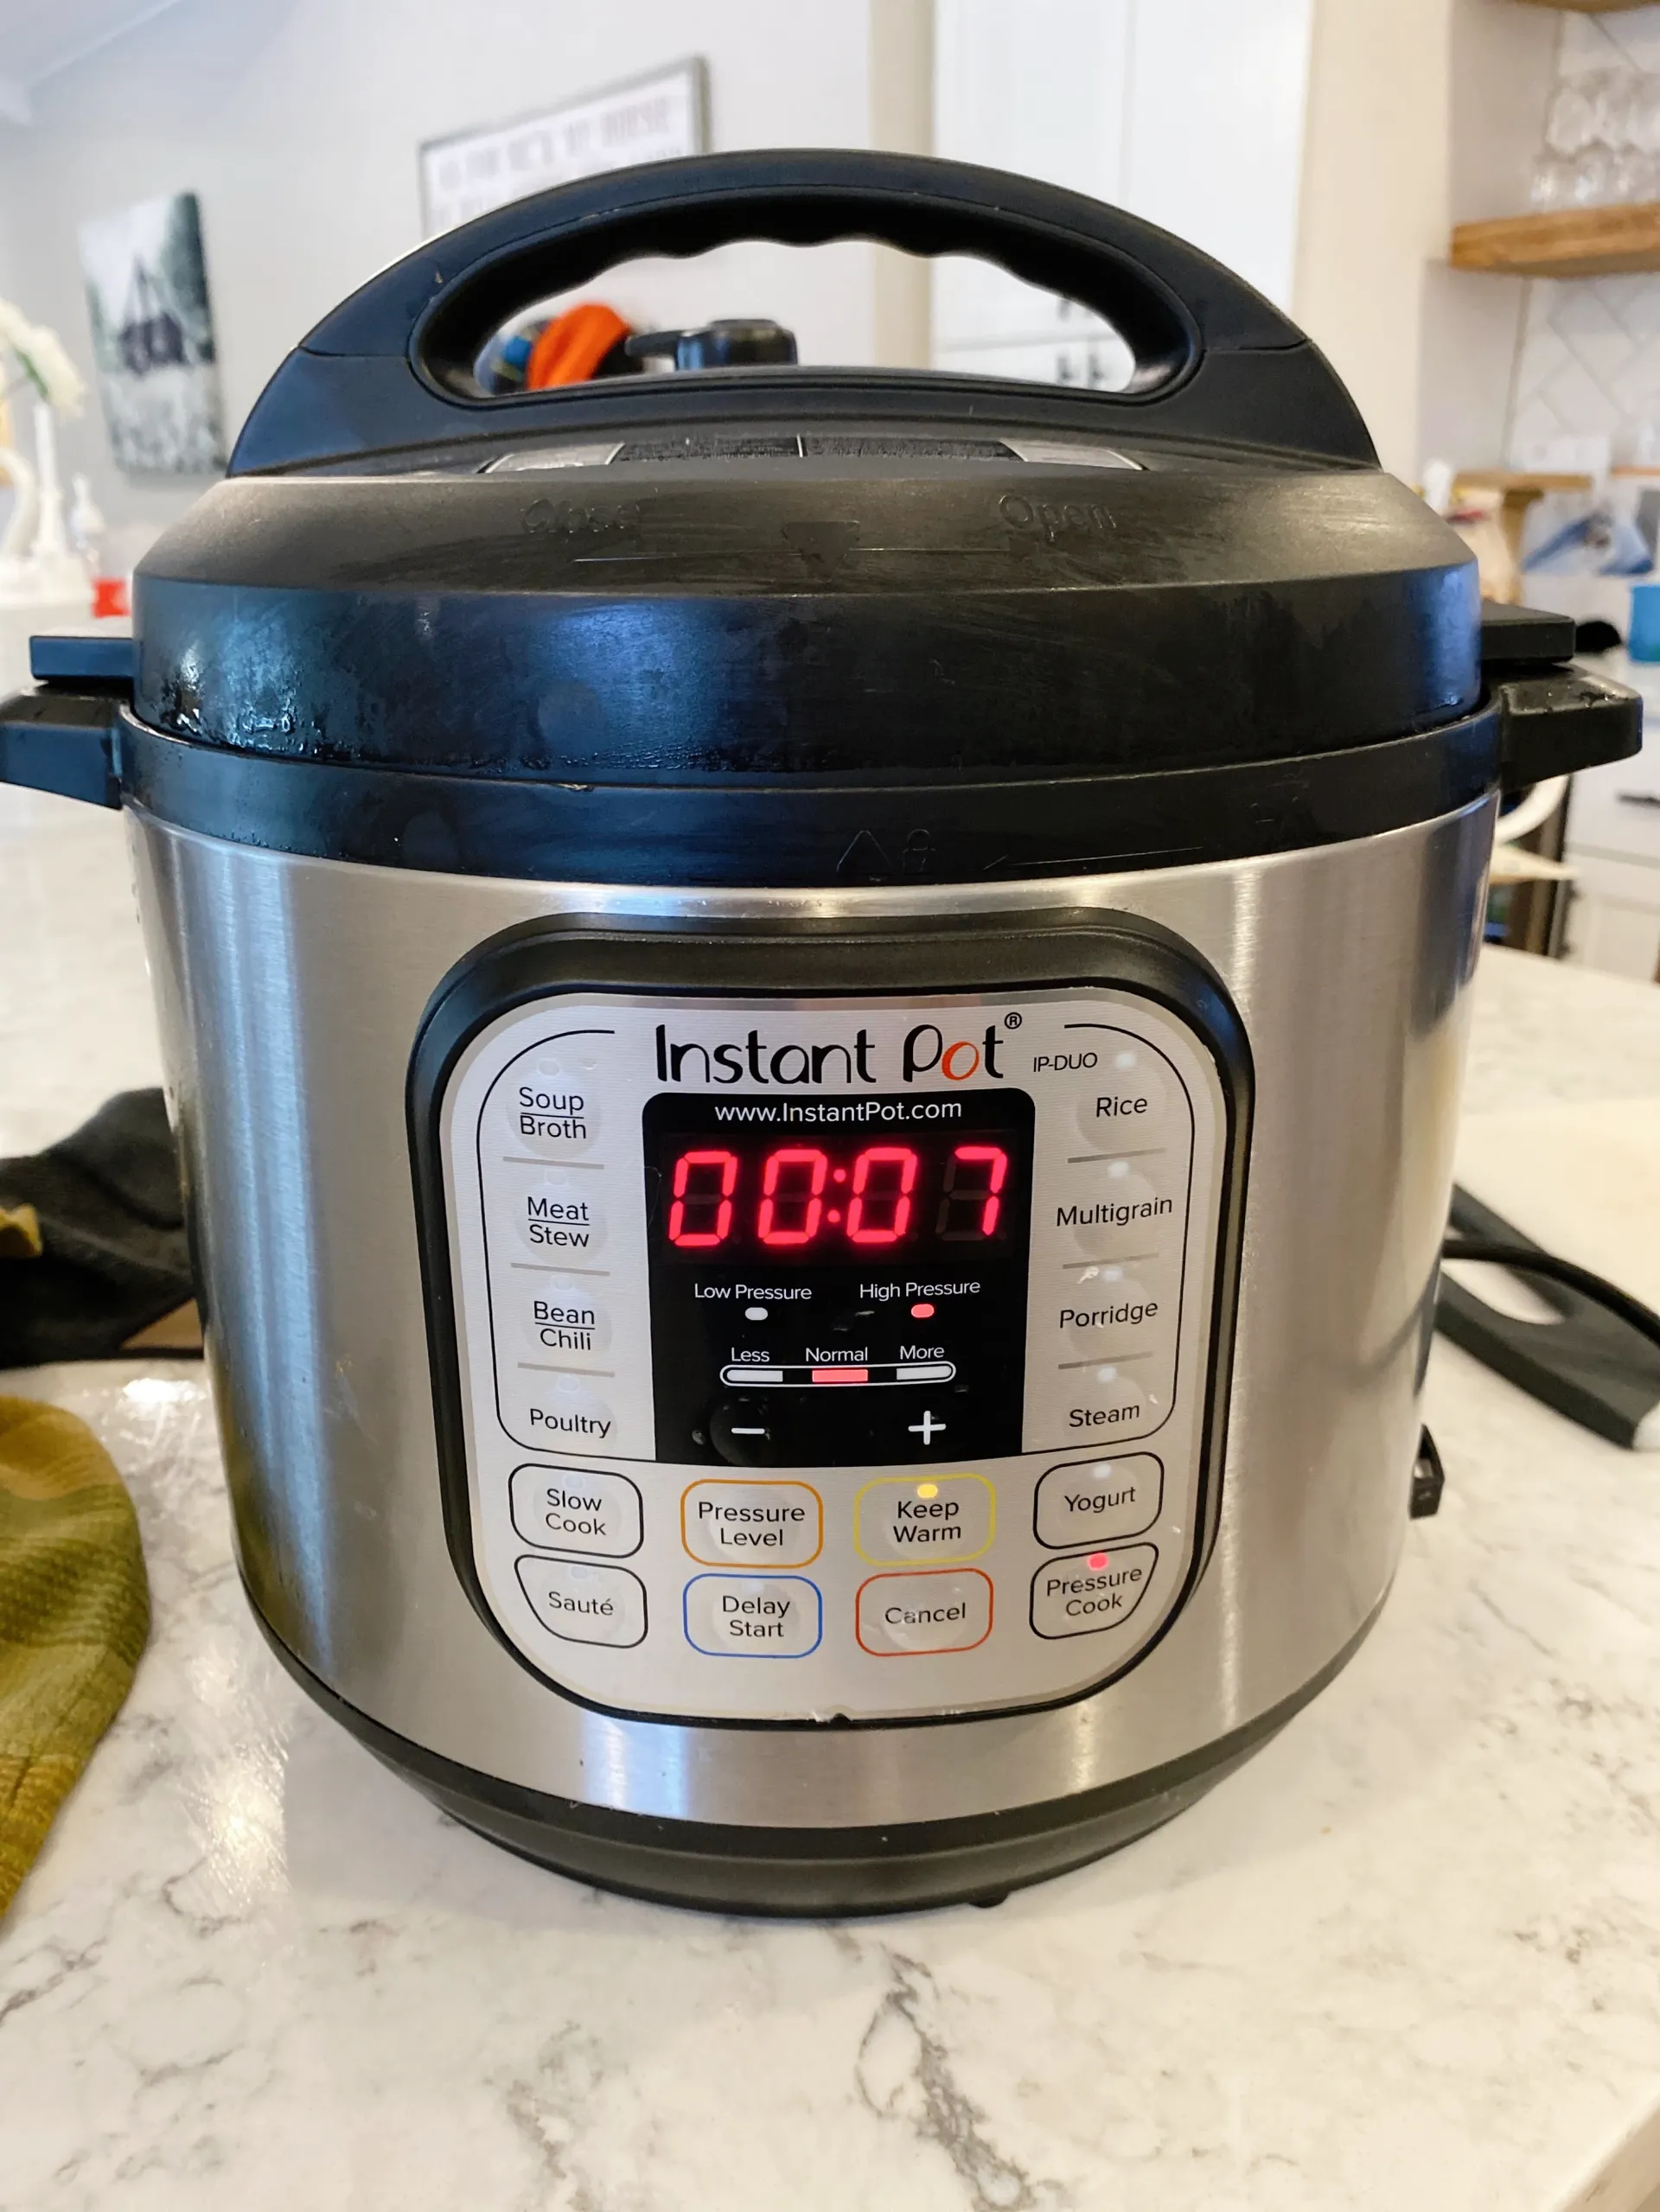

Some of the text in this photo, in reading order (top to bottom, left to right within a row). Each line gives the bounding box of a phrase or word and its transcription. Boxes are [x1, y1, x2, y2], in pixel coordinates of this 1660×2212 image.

[997, 494, 1117, 543] Open
[655, 1023, 876, 1085] Instant
[1032, 1051, 1099, 1074] IP-DUO
[519, 1087, 584, 1115] Soup
[714, 1100, 962, 1123] www.InstantPot.com
[1095, 1094, 1149, 1119] Rice
[520, 1116, 588, 1140] Broth
[527, 1196, 590, 1221] Meat
[1056, 1196, 1174, 1227] Multigrain
[528, 1224, 591, 1248] Stew
[694, 1283, 813, 1301] Low Pressure
[859, 1279, 981, 1302] High Pressure
[533, 1300, 596, 1325] Bean
[1059, 1300, 1159, 1329] Porridge
[540, 1329, 592, 1351] Chili
[731, 1348, 770, 1363] Less
[806, 1346, 869, 1363] Normal
[899, 1344, 945, 1361] More
[529, 1408, 612, 1438] Poultry
[1069, 1404, 1140, 1429] Steam
[546, 1488, 603, 1512] Slow
[698, 1501, 806, 1522] Pressure
[897, 1498, 960, 1521] Keep
[1063, 1485, 1137, 1514] Yogurt
[545, 1512, 607, 1536] Cook
[892, 1524, 962, 1544] Warm
[719, 1527, 784, 1546] Level
[1045, 1566, 1143, 1597] Pressure
[547, 1591, 615, 1616] Sauté
[722, 1594, 791, 1618] Delay
[884, 1602, 967, 1625] Cancel
[1065, 1592, 1123, 1617] Cook
[729, 1619, 785, 1639] Start
